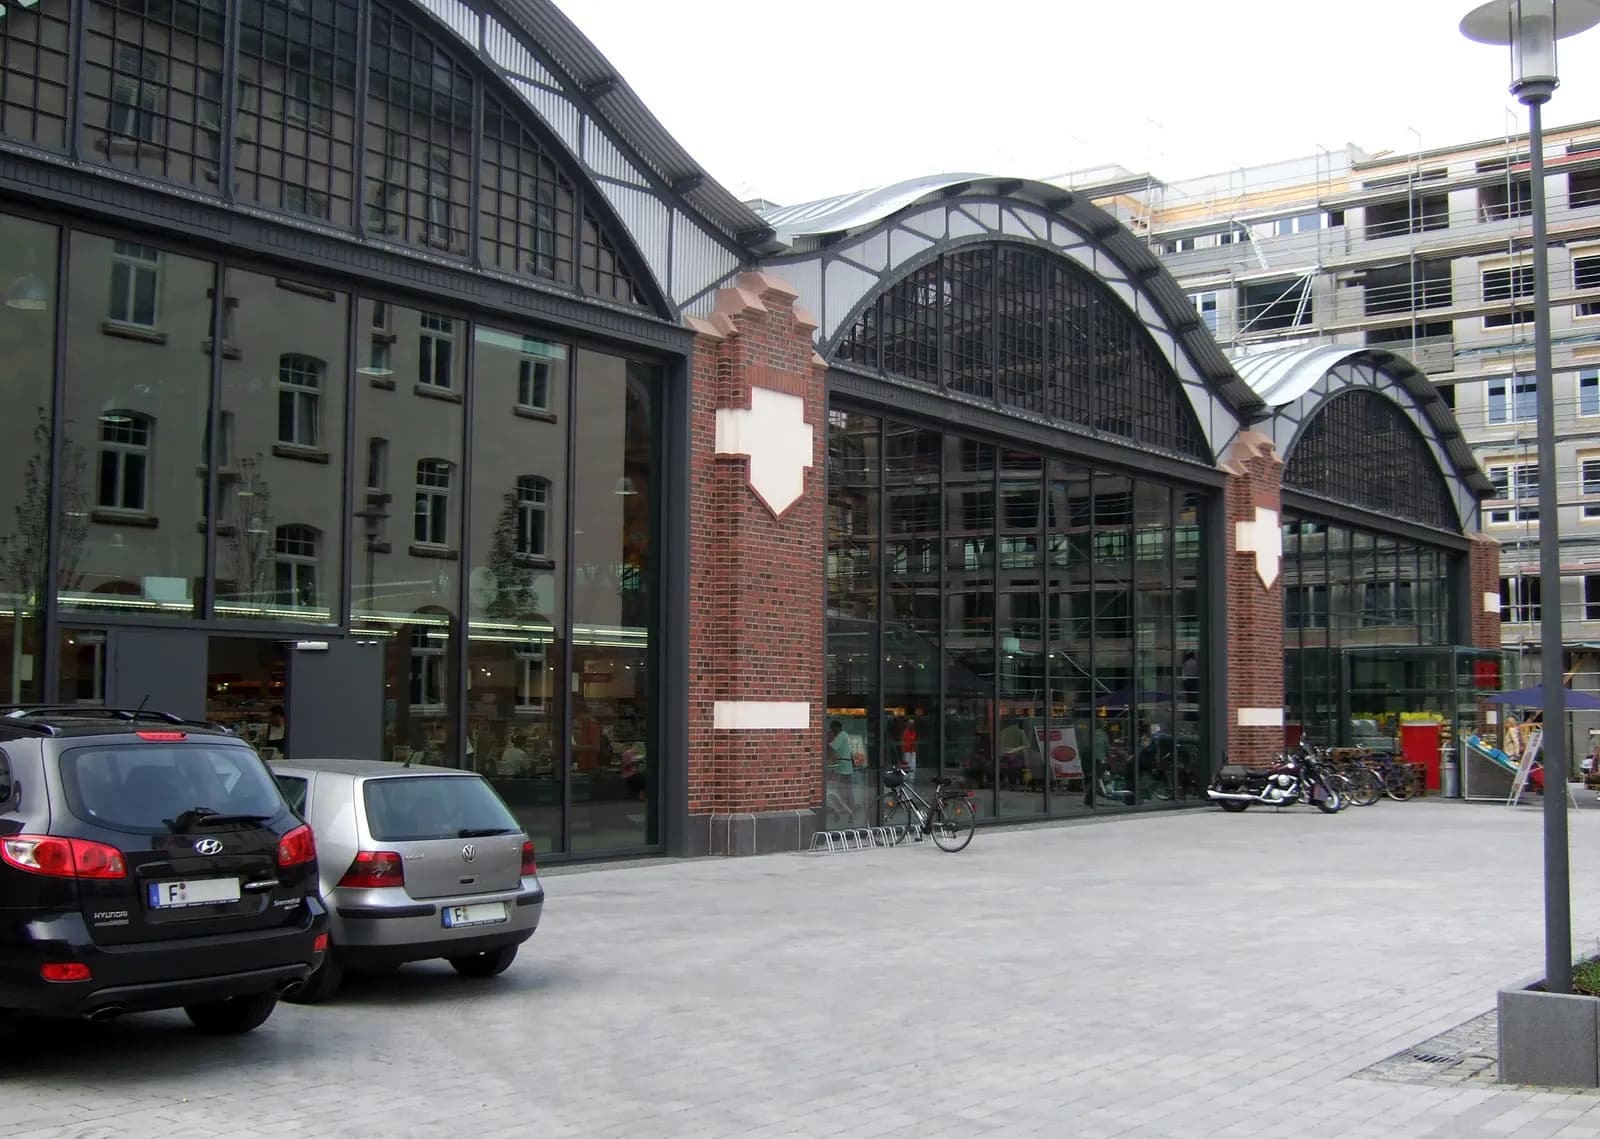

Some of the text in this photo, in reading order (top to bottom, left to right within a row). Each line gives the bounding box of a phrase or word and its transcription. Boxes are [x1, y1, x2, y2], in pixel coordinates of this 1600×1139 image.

[169, 884, 178, 902] F
[94, 910, 129, 919] HYUNDAI
[455, 908, 462, 922] F
